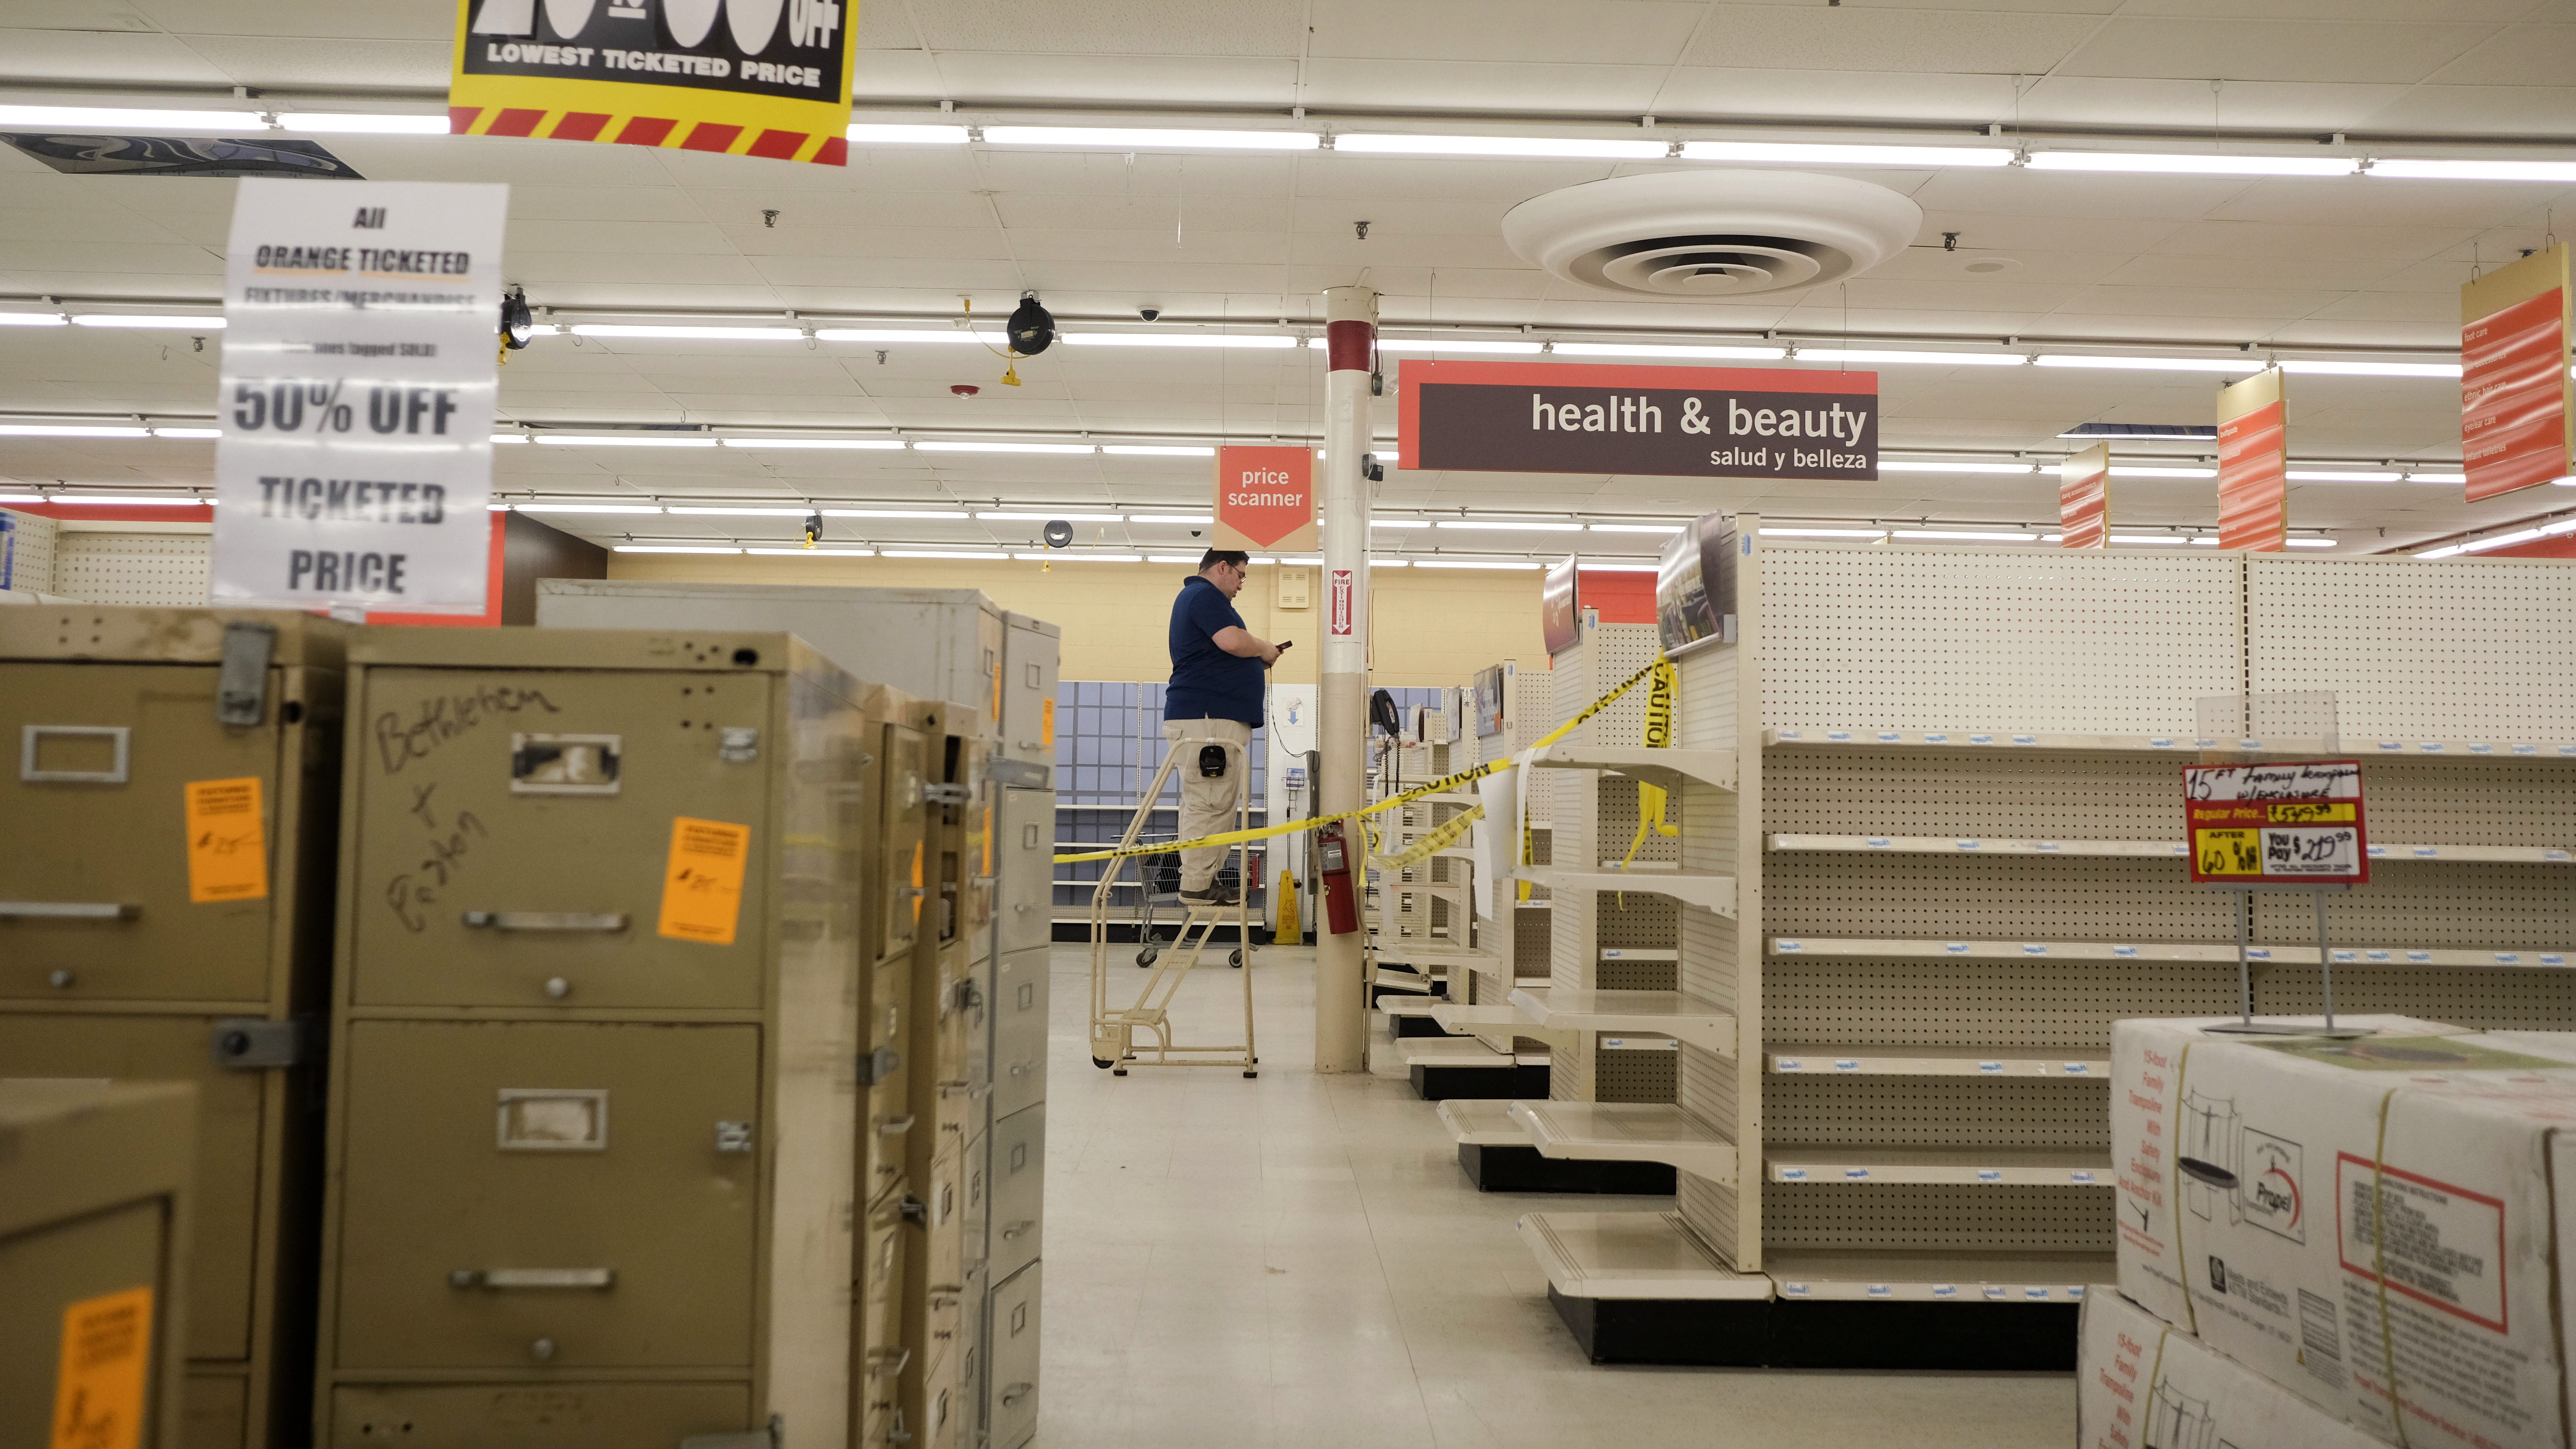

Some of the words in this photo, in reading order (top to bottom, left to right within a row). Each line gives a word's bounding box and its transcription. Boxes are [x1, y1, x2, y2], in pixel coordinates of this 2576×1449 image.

[487, 43, 594, 67] LOWEST
[602, 49, 731, 78] TICKETED
[740, 60, 821, 88] PRICE
[255, 244, 350, 271] ORANGE
[359, 248, 471, 275] TICKETED
[2465, 331, 2475, 342] foot
[2476, 327, 2488, 338] care
[2464, 388, 2480, 401] ethnic
[2482, 386, 2493, 395] hair
[2494, 381, 2506, 391] care
[233, 378, 352, 433] 50%
[369, 384, 458, 435] OFF
[1532, 393, 1662, 433] health
[1680, 396, 1711, 435] &
[1730, 398, 1867, 447] beauty
[2464, 419, 2483, 433] eye/ear
[2484, 416, 2496, 426] care
[2220, 426, 2238, 438] toothpaste
[1710, 447, 1766, 466] salud
[1774, 452, 1786, 471] y
[1793, 449, 1866, 469] belleza
[2466, 451, 2481, 462] infant
[2483, 444, 2506, 456] toiletries
[1242, 467, 1289, 488] price
[258, 476, 446, 525] TICKETED
[1228, 492, 1302, 506] scanner
[288, 549, 408, 594] PRICE
[1646, 663, 1666, 748] CAUTIO
[2193, 809, 2230, 821] Regular
